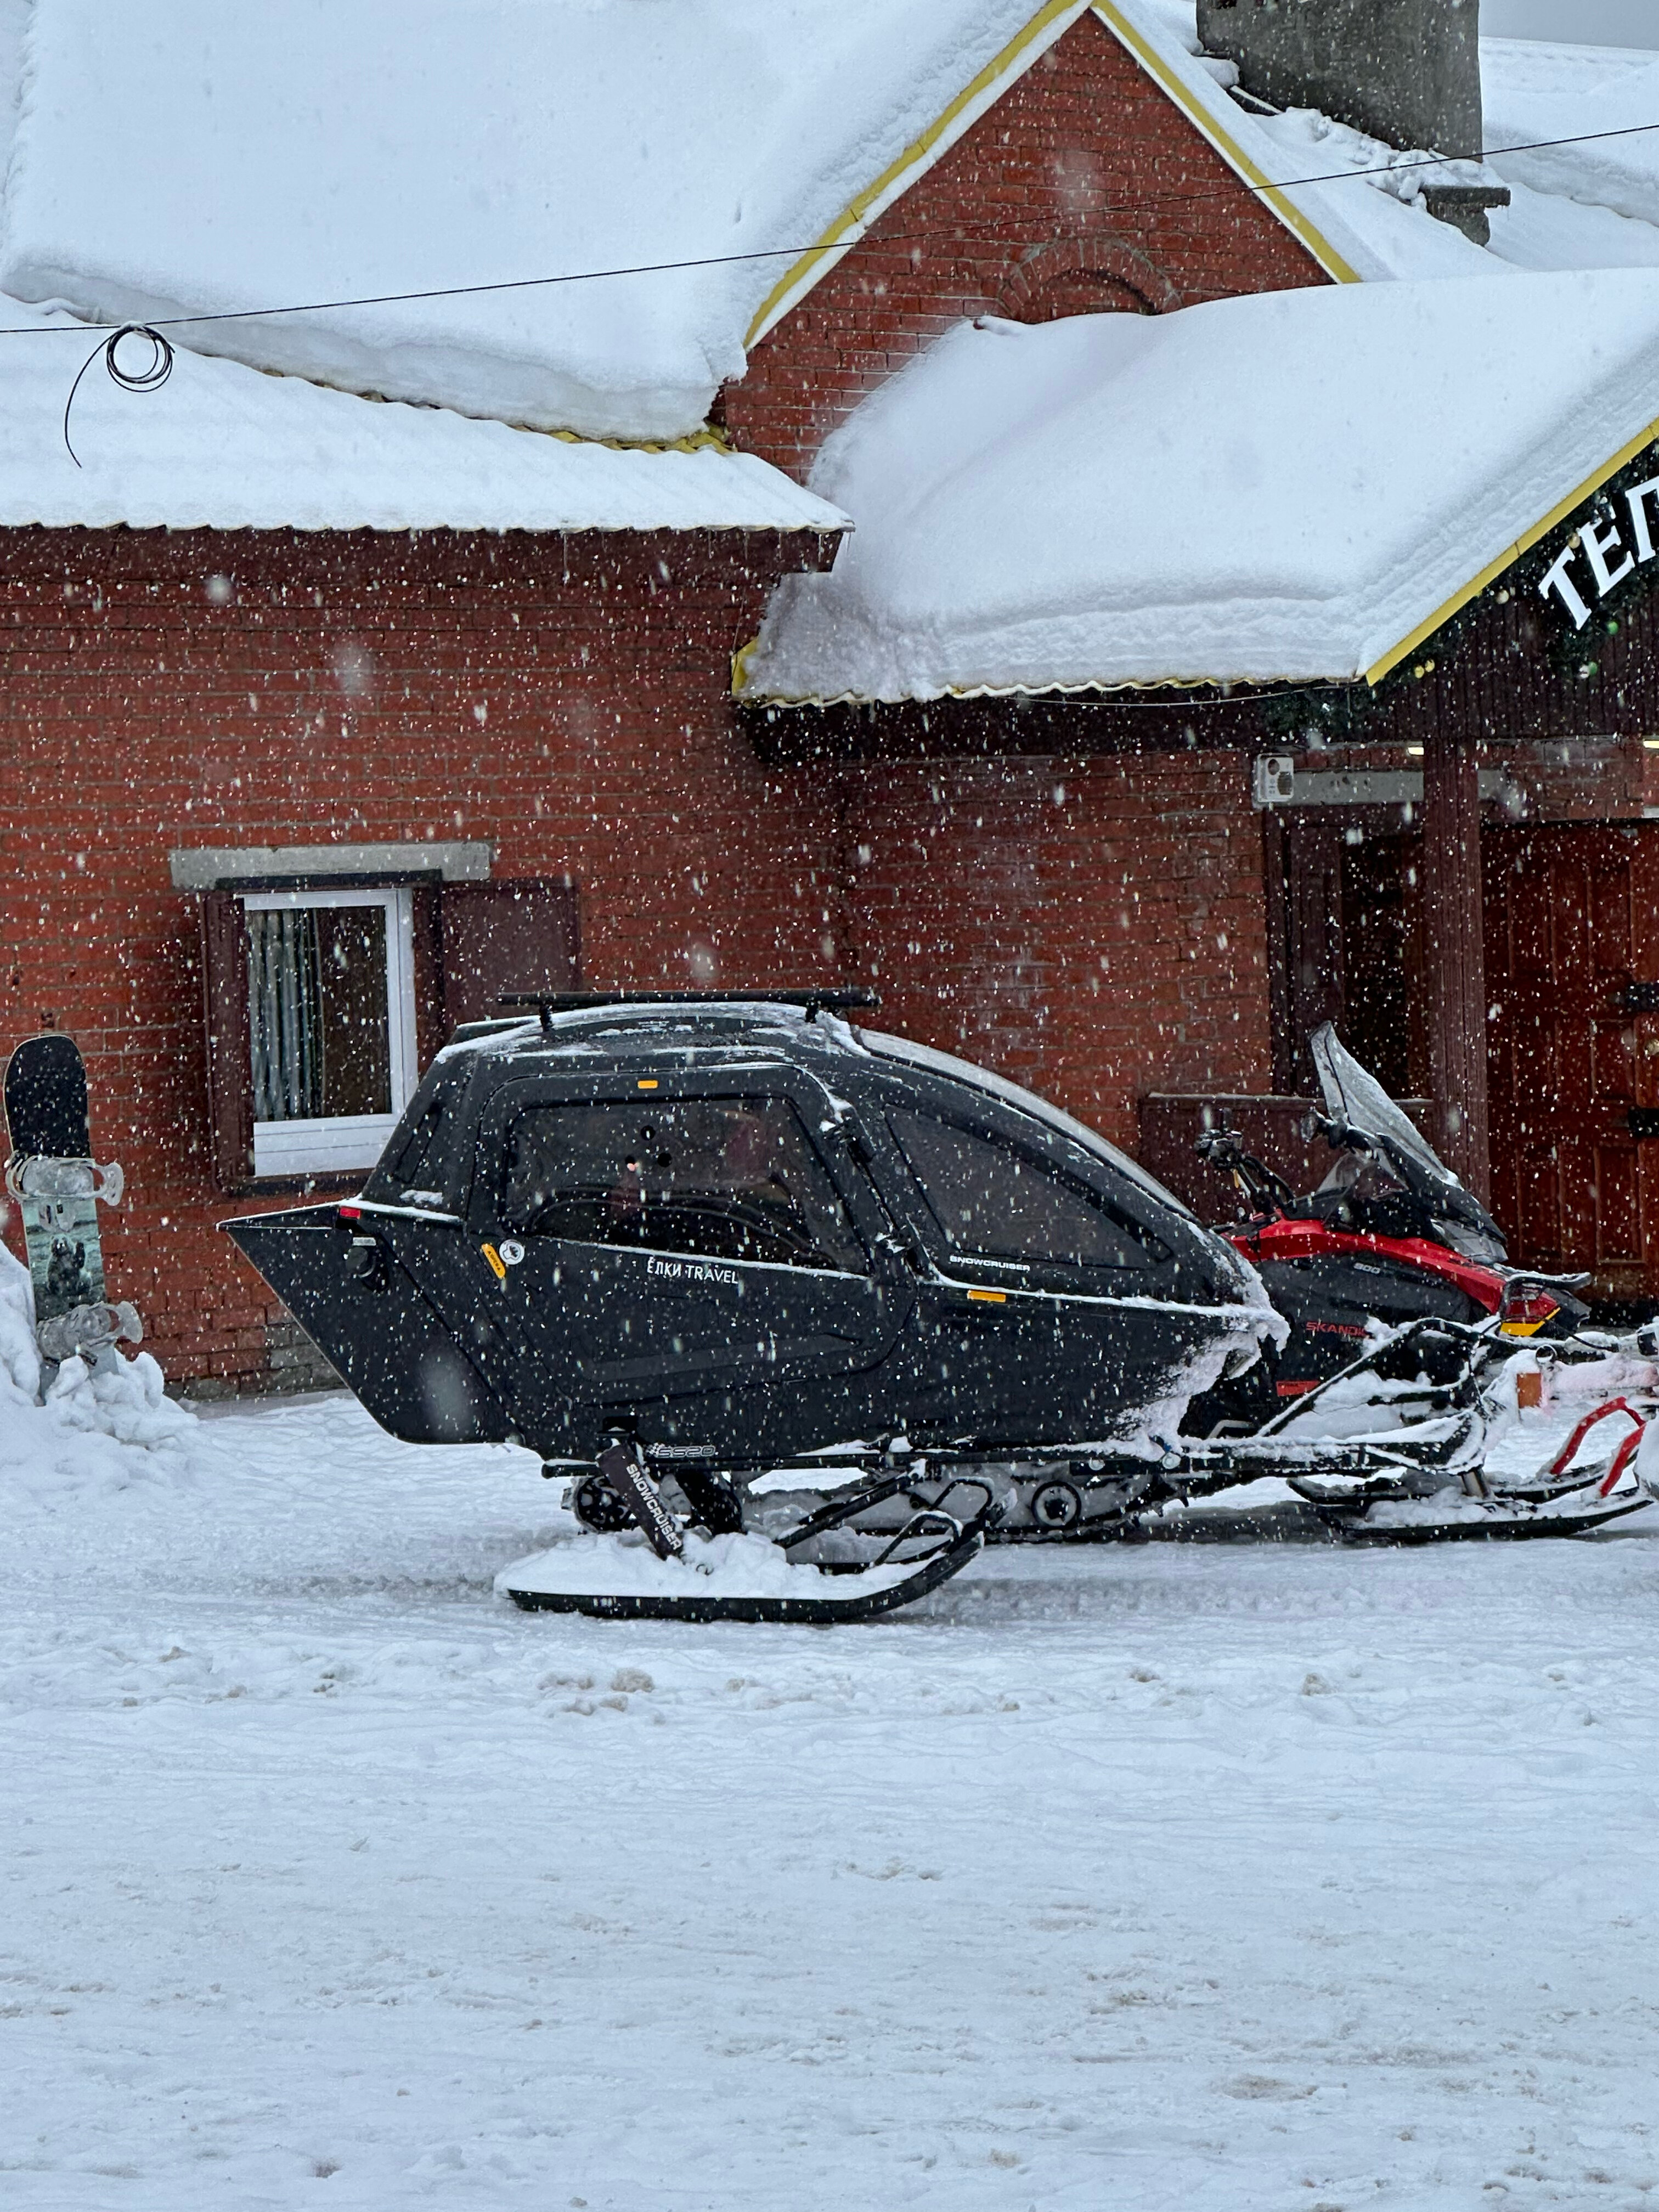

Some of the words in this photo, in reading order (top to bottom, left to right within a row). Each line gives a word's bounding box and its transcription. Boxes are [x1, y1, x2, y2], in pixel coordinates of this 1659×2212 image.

[950, 1255, 1030, 1273] SNOWCRUISER
[686, 1265, 738, 1284] TRAVEL
[627, 1463, 682, 1550] SNOWCRUISER
